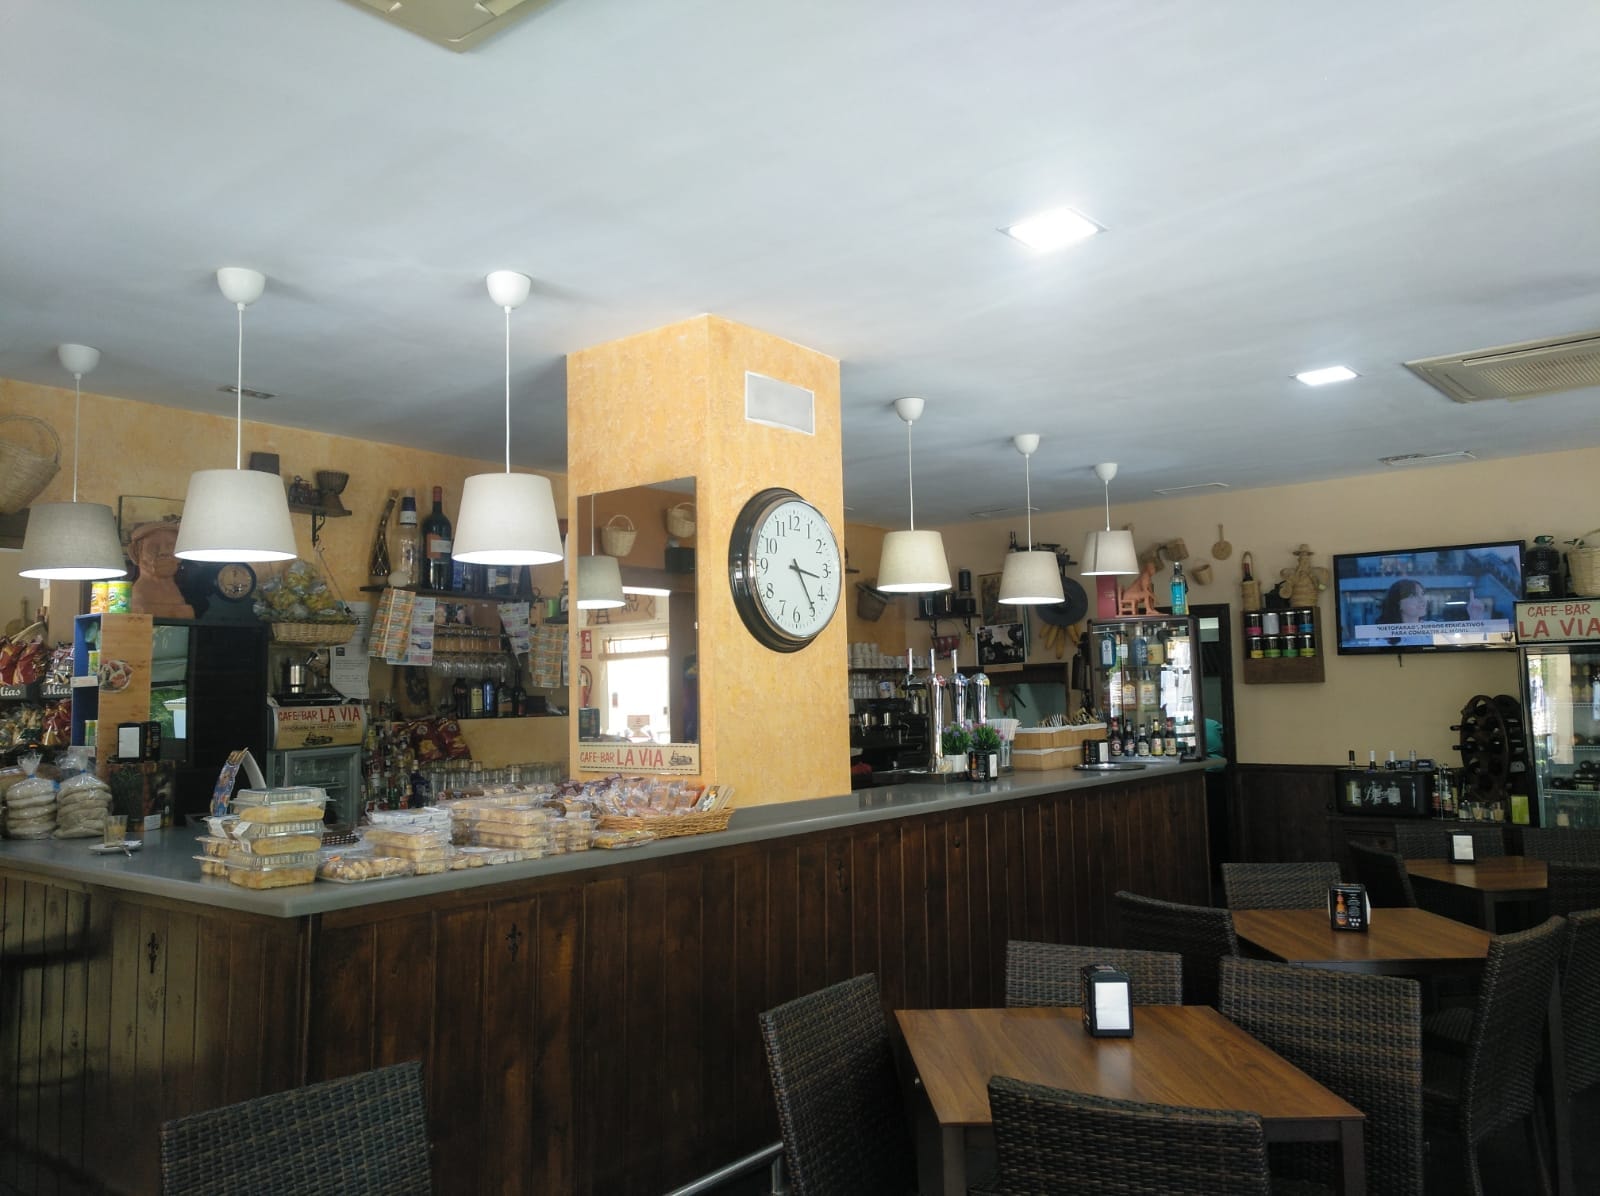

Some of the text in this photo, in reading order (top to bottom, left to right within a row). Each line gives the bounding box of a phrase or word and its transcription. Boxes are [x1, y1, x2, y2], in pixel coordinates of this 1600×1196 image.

[776, 520, 787, 537] 11
[789, 515, 801, 532] 12
[806, 523, 811, 539] 1
[765, 537, 778, 554] 10
[815, 538, 823, 554] 2
[760, 557, 769, 575] 9
[822, 563, 829, 579] 3
[766, 582, 774, 599] 8
[817, 585, 825, 600] 4
[779, 600, 786, 616] 7
[792, 606, 801, 623] 6
[808, 601, 816, 618] 5
[1527, 603, 1591, 618] CAFE-BAR
[1519, 616, 1600, 638] LA VIA
[320, 707, 336, 722] LA
[340, 706, 361, 721] VIA
[580, 748, 663, 768] CAFE-BAR LA VIA
